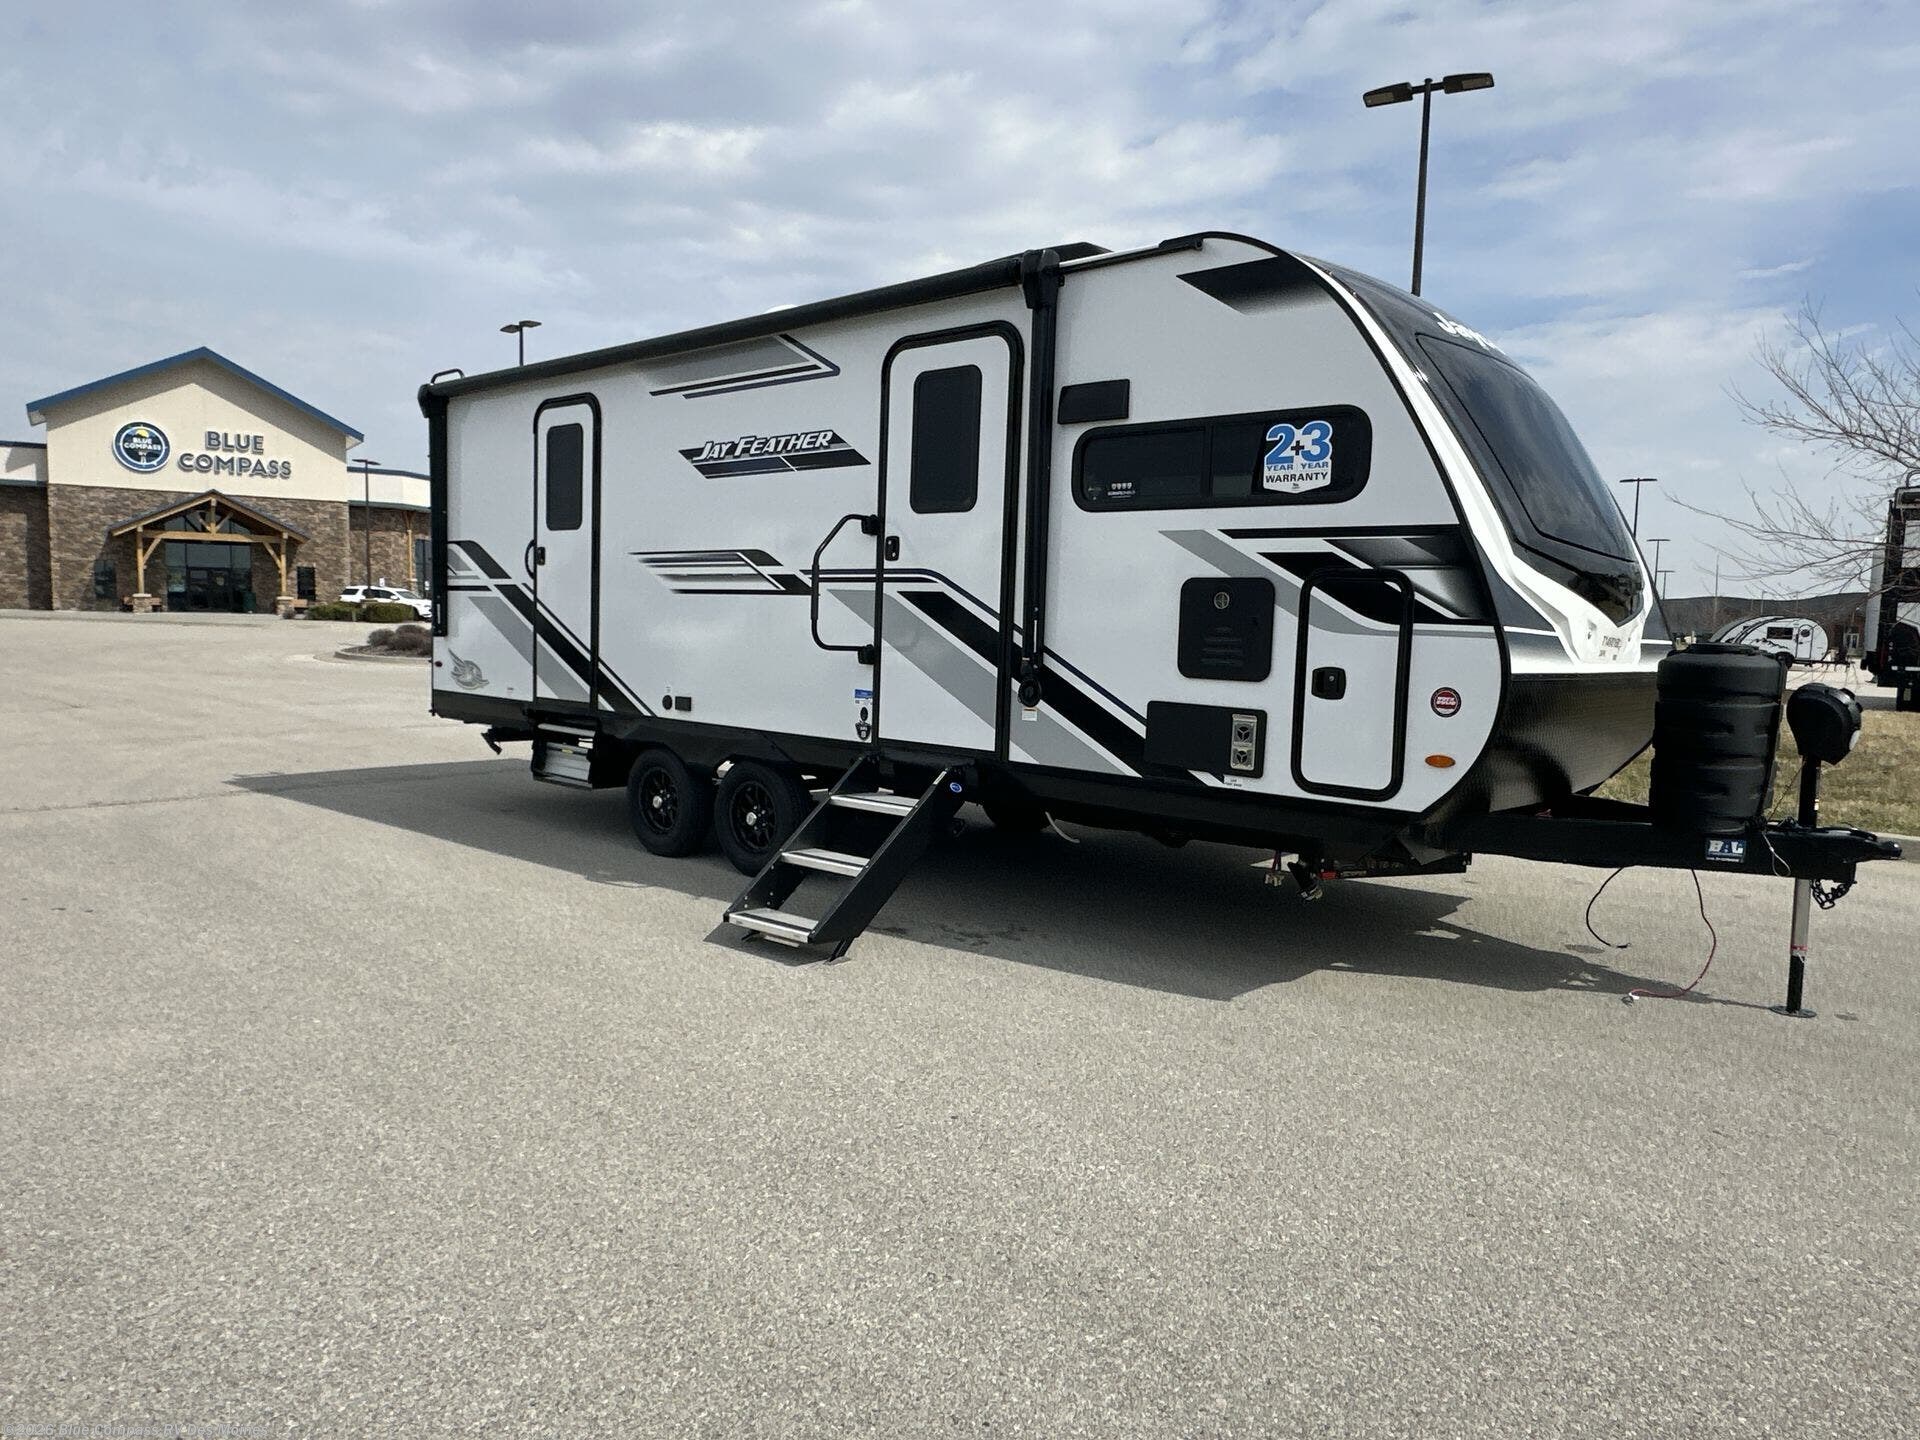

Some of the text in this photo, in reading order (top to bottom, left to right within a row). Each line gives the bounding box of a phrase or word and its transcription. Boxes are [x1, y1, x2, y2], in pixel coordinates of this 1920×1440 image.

[205, 431, 264, 454] BLUE
[734, 431, 833, 457] FEATHER
[178, 453, 292, 479] COMPASS
[1265, 472, 1328, 482] WARRANTY
